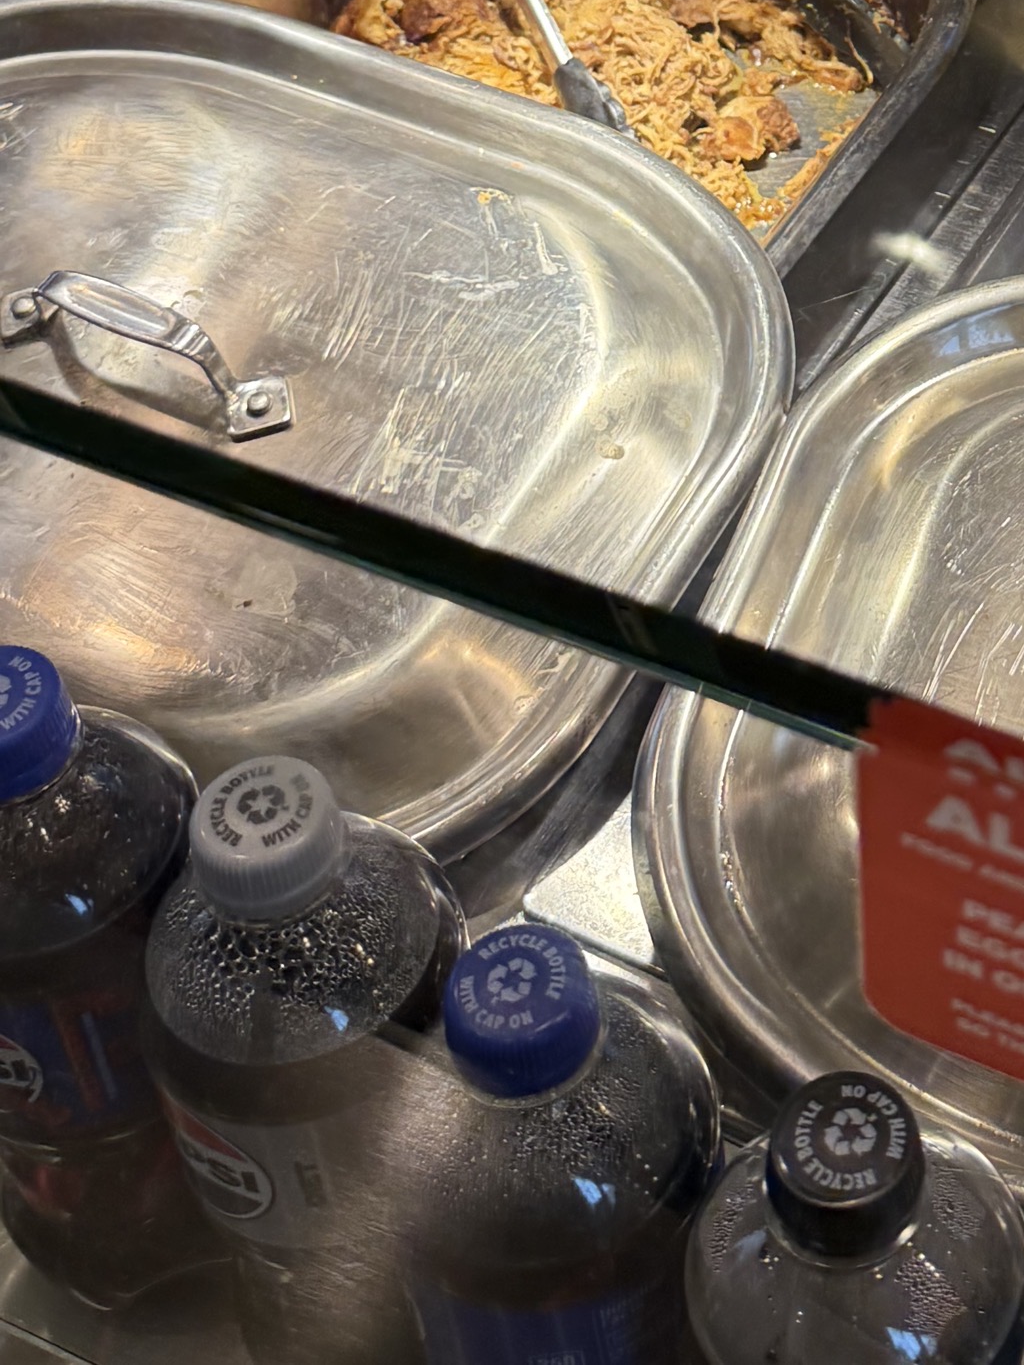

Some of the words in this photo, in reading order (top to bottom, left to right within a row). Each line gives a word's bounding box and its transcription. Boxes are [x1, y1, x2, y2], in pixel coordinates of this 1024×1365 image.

[0, 697, 37, 731] WITH
[24, 671, 43, 696] CAP
[220, 763, 275, 795] BOTTLE
[209, 796, 243, 847] RECYCLE
[261, 818, 302, 848] WITH
[294, 792, 313, 819] CAP
[478, 934, 549, 961] RECYCLE
[542, 946, 567, 1001] BOTTLE
[941, 947, 984, 980] IN
[459, 974, 479, 1015] WITH
[475, 1008, 505, 1030] CAP
[509, 1009, 535, 1030] ON
[841, 1084, 866, 1098] ON
[867, 1091, 898, 1116] CAP
[794, 1100, 824, 1161] BOTTLE
[885, 1118, 907, 1160] WITH
[803, 1157, 877, 1191] RECYCLE
